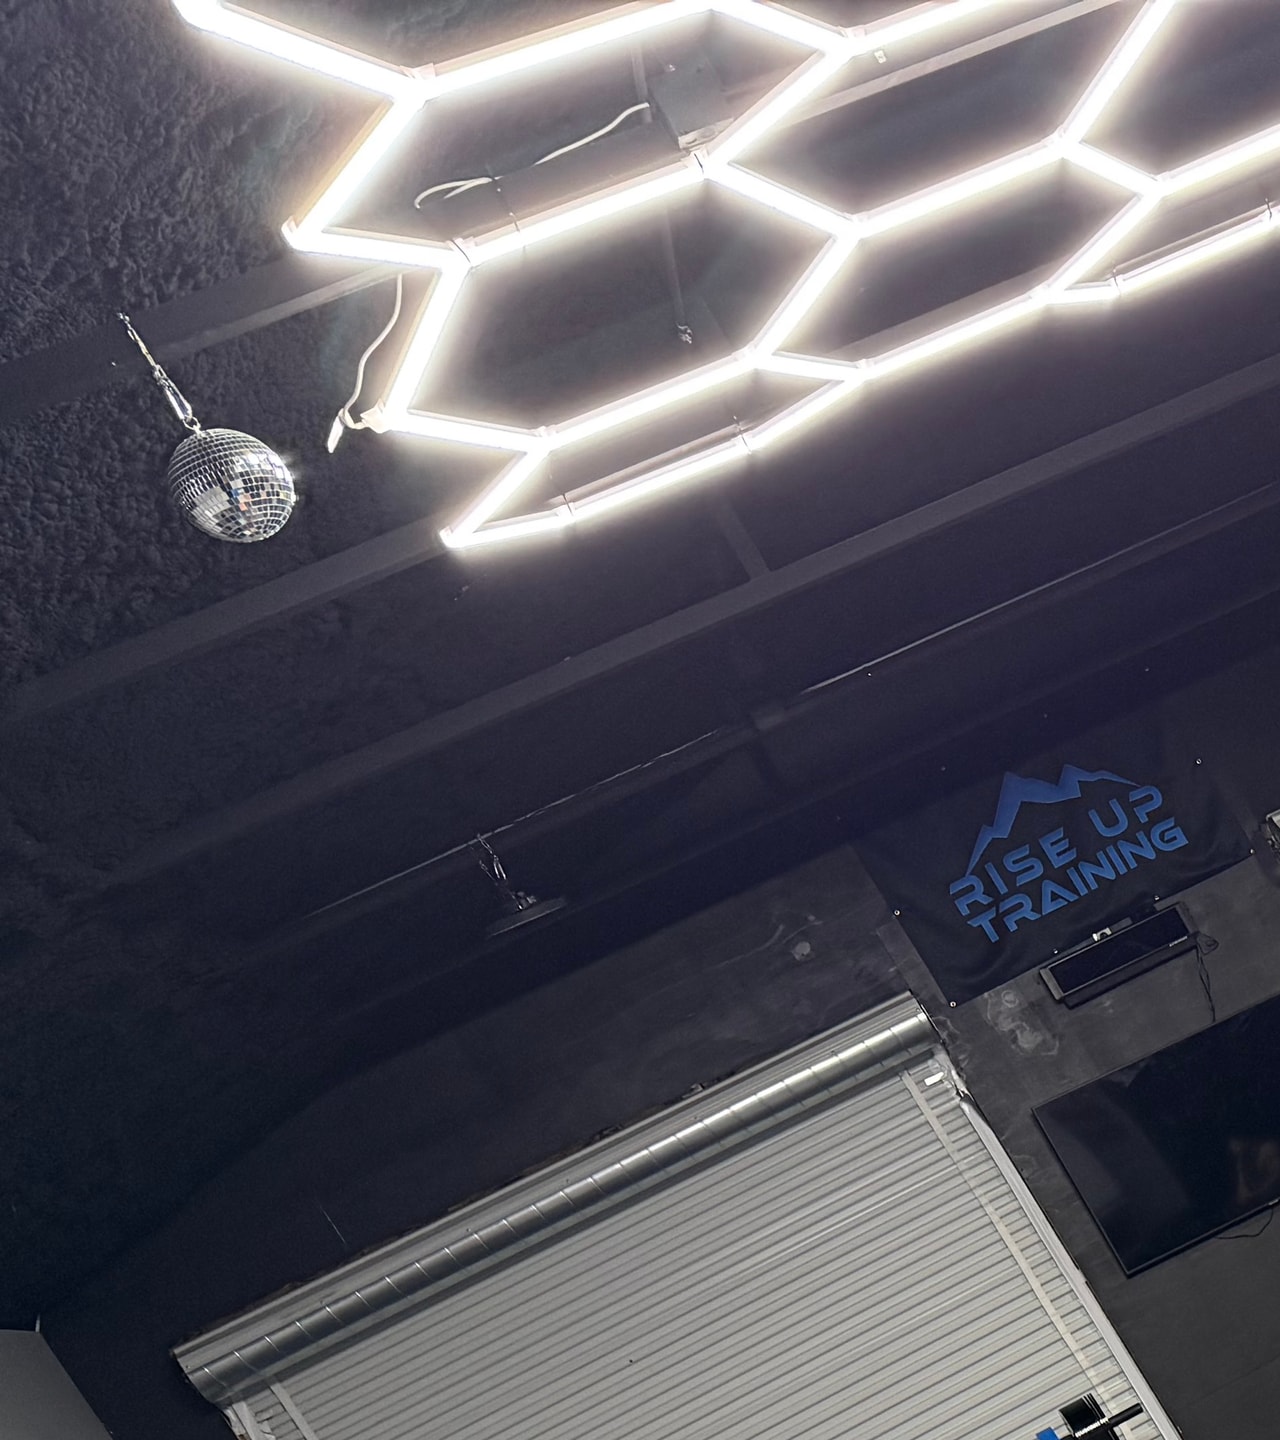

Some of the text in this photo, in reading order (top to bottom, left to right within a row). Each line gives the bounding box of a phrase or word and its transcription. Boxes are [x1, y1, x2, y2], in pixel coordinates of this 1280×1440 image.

[949, 786, 1163, 917] RISE UP
[967, 816, 1189, 943] TRAINING
